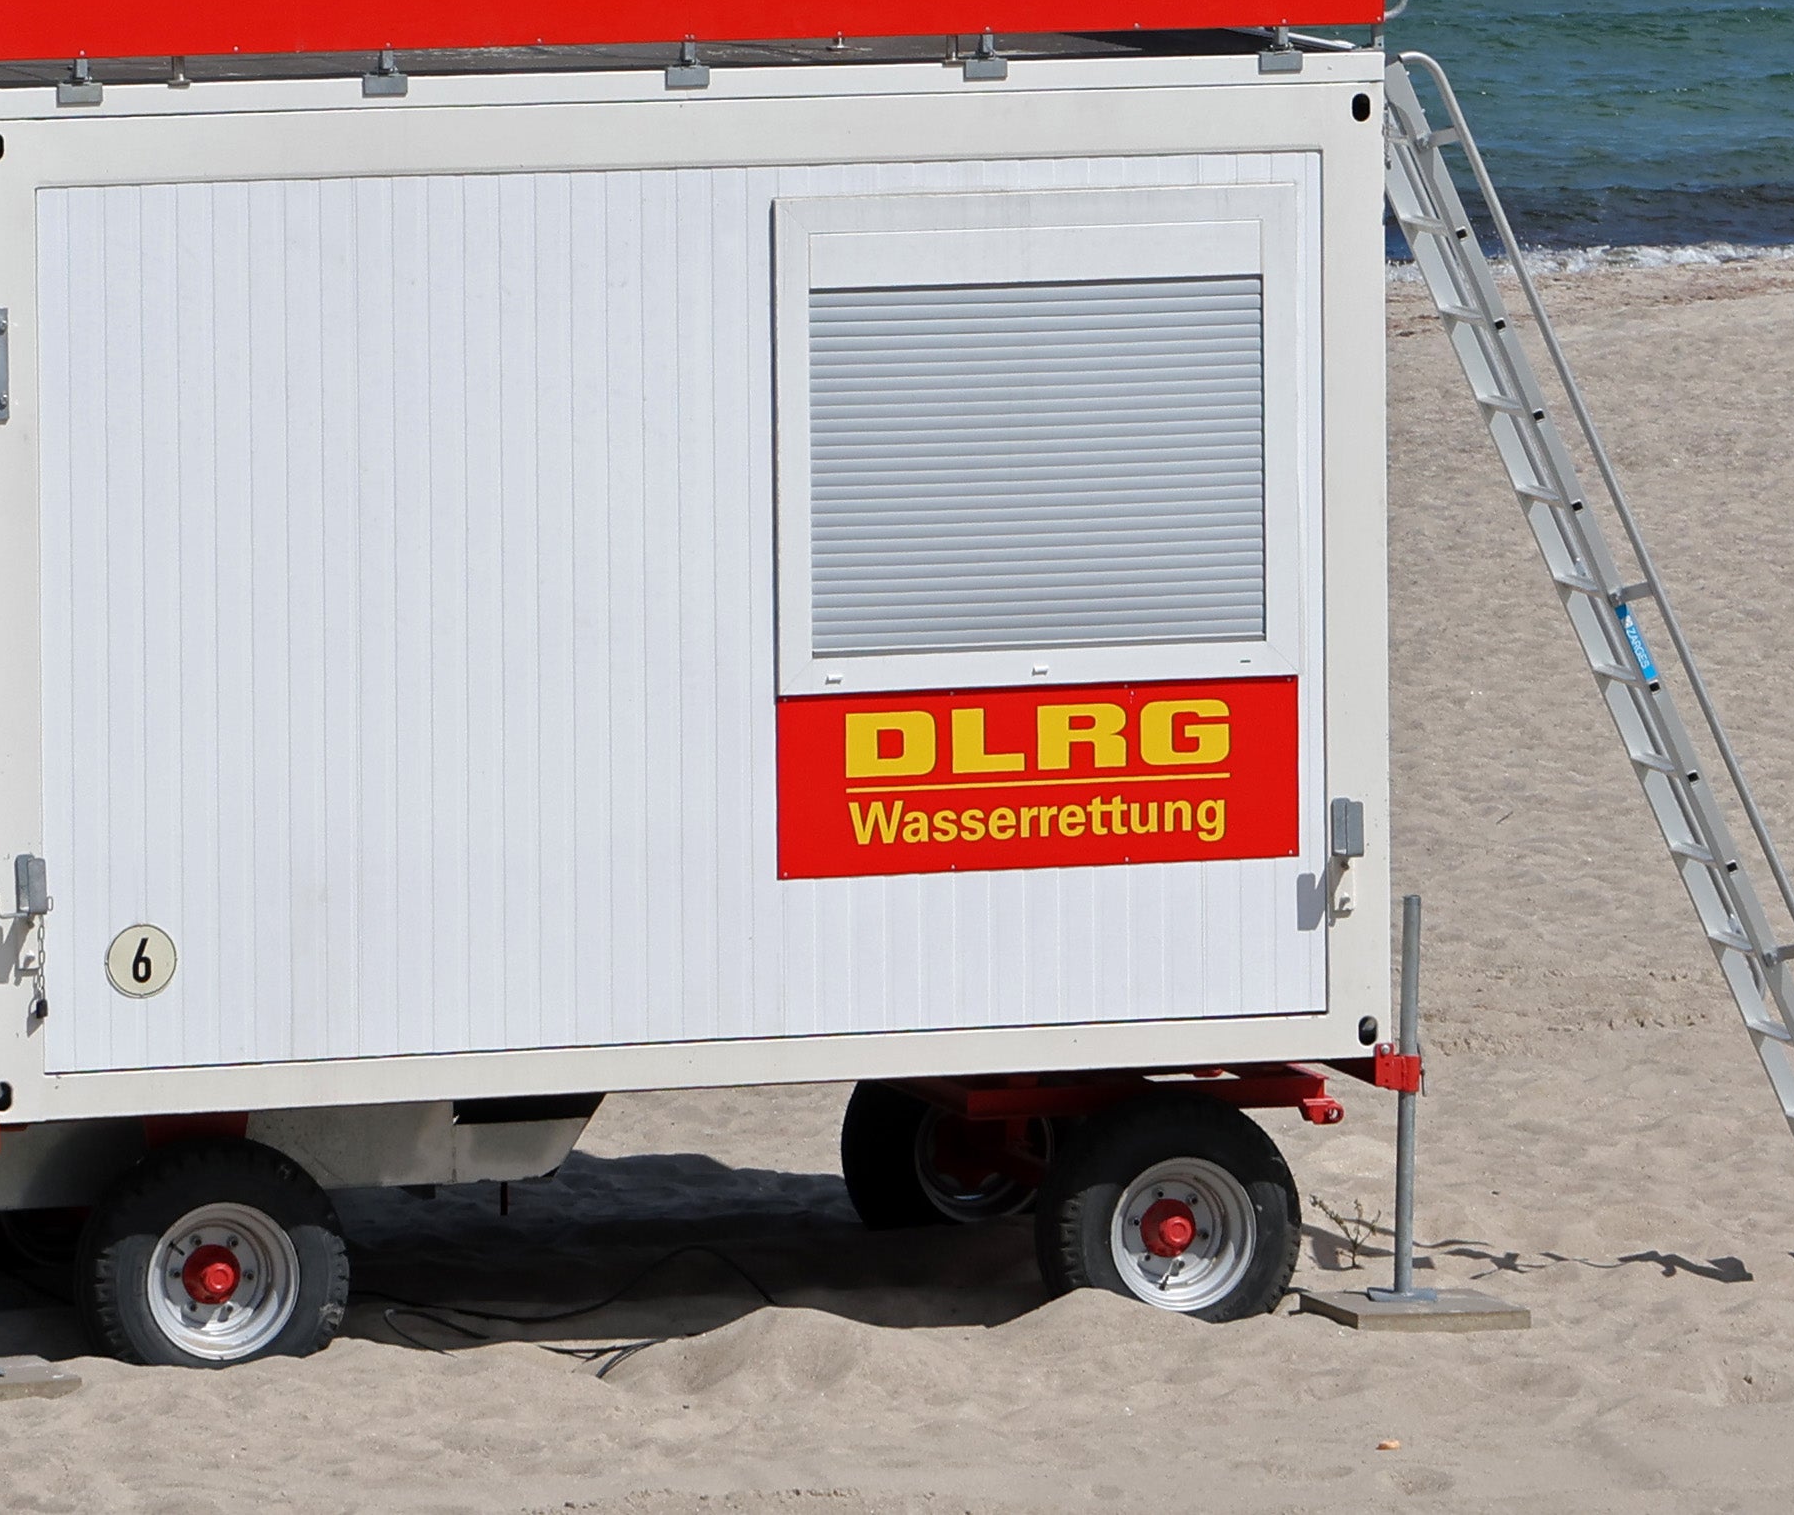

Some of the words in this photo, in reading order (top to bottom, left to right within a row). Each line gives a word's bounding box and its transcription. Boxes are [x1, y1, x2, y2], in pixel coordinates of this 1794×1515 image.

[1626, 627, 1651, 669] ZARGES
[845, 699, 1230, 778] DLRG
[848, 795, 1226, 845] Wasserrettung
[132, 937, 152, 984] 6
